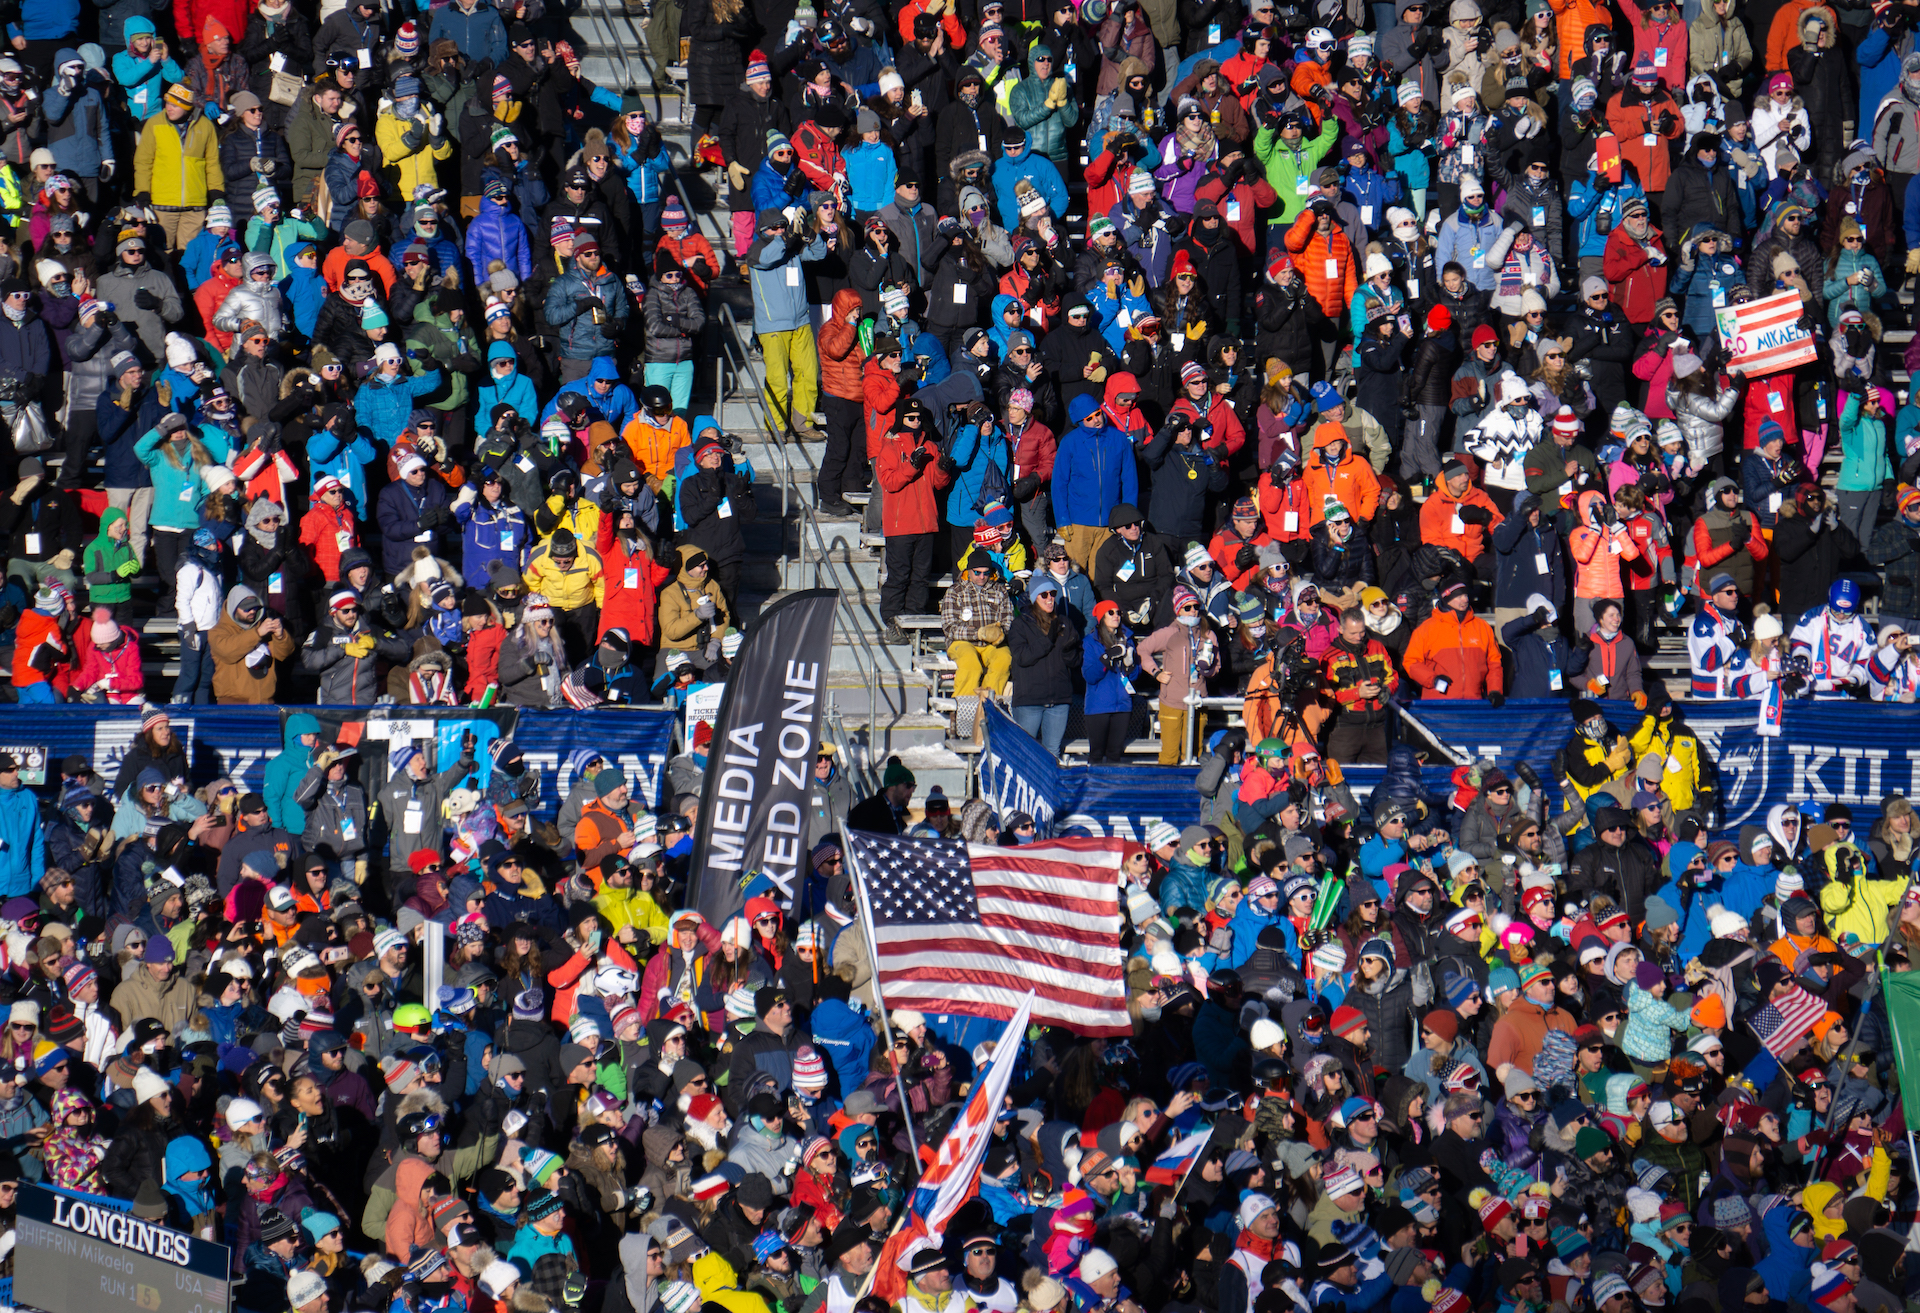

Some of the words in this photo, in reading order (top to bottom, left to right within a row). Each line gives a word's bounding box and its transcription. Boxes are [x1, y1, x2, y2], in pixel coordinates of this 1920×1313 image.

[1725, 336, 1747, 356] GO
[772, 660, 819, 790] ZONE
[0, 746, 39, 754] ANDFILL
[707, 722, 763, 872] MEDIA
[17, 1221, 77, 1256] SHIFFRIN
[80, 1243, 134, 1275] Mikaela
[52, 1195, 190, 1266] LONGINES
[100, 1275, 126, 1298] RUN
[142, 1287, 152, 1306] 5
[175, 1271, 203, 1297] USA
